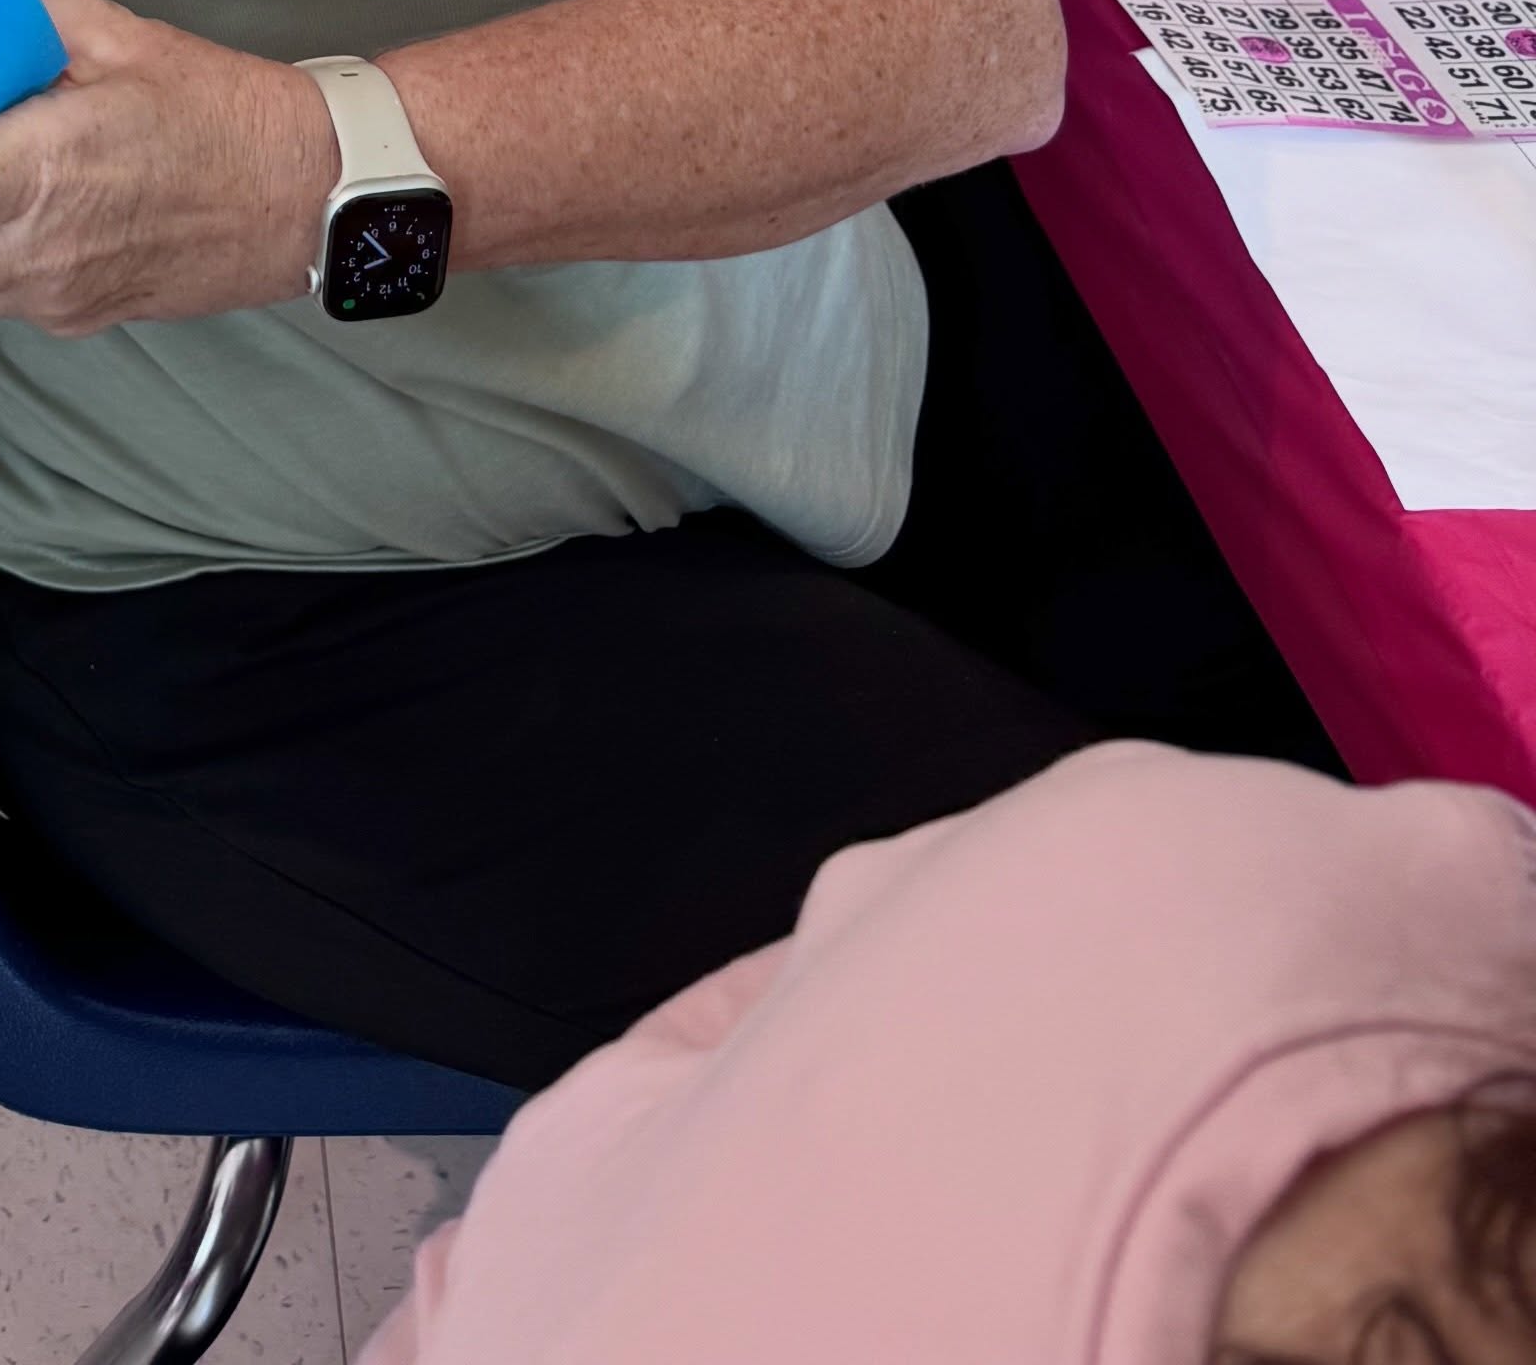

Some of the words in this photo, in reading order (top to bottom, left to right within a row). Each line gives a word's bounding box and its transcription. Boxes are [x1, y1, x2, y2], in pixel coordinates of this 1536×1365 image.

[1481, 1, 1523, 26] 30
[1137, 2, 1172, 22] 16
[1159, 27, 1194, 50] 42
[1182, 55, 1219, 80] 46
[1202, 86, 1243, 112] 75
[1176, 2, 1215, 26] 28
[1202, 30, 1239, 54] 45
[1222, 59, 1264, 84] 57
[1247, 88, 1288, 114] 65
[1437, 3, 1481, 28] 25
[1465, 34, 1506, 59] 38
[1492, 64, 1534, 89] 60
[1217, 6, 1258, 30] 27
[1266, 64, 1305, 88] 56
[1290, 95, 1331, 115] 71
[1260, 7, 1300, 30] 29
[1284, 36, 1324, 60] 39
[1308, 67, 1348, 91] 53
[1333, 98, 1374, 121] 62
[1305, 9, 1343, 29] 18
[1327, 36, 1368, 60] 35
[1354, 68, 1395, 92] 47
[1378, 101, 1420, 123] 74
[1395, 6, 1436, 30] 22
[1425, 36, 1463, 60] 42
[1448, 67, 1490, 89] 51
[1475, 97, 1517, 121] 71
[417, 234, 425, 245] 8
[348, 257, 356, 268] 3
[422, 248, 430, 260] 9
[353, 272, 361, 282] 2
[397, 276, 408, 287] 11
[409, 264, 422, 275] 10
[379, 284, 392, 295] 12
